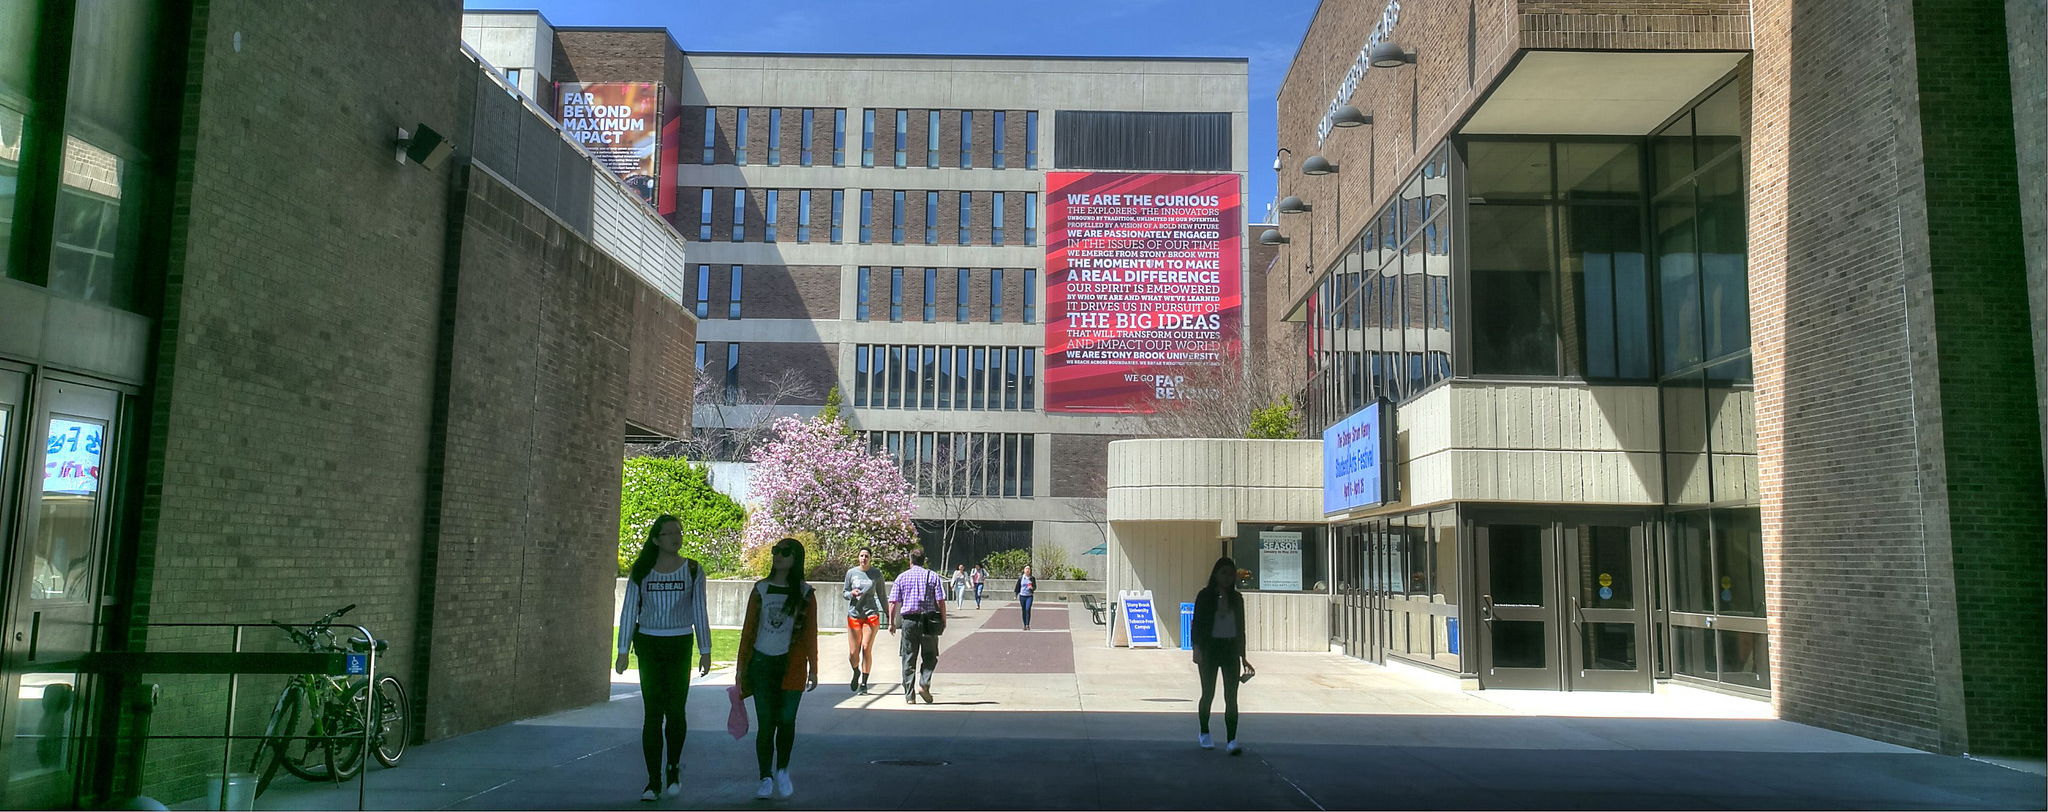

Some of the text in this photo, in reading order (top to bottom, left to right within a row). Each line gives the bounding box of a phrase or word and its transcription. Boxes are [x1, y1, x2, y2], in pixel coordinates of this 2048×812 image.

[564, 92, 594, 105] FAR
[563, 105, 631, 118] BEYOND
[563, 118, 644, 131] MAXIMUM
[567, 131, 623, 144] MPACT
[1067, 194, 1219, 207] WE ARE THE CURIOUS
[1067, 206, 1085, 214] THE
[1161, 208, 1220, 216] INNOVATORS
[1083, 230, 1103, 238] ARE
[1104, 230, 1172, 239] PASSIONATELY
[1173, 231, 1220, 239] ENGAGED
[1067, 239, 1220, 250] IN THE ISSUES OF OUR TIME
[1067, 259, 1091, 268] THE
[1166, 259, 1183, 269] TO
[1185, 260, 1220, 269] MAKE
[1067, 270, 1220, 284] A REAL DIFFERENCE
[1067, 283, 1220, 294] OUR SPIRIT IS EMPOWERED
[1067, 302, 1220, 313] IT DRIVES US IN PURSUIT OF
[1067, 312, 1220, 330] THE BIG IDEAS
[1092, 330, 1115, 338] WILL
[1116, 330, 1172, 339] TRANSFORM
[1174, 331, 1194, 339] OUR
[1195, 331, 1220, 339] LIVES
[1066, 339, 1220, 351] AND IMPACT OUR WORLD
[1166, 352, 1220, 360] UNIVERSITY
[1124, 374, 1139, 382] WE
[1349, 452, 1357, 474] Arts
[1357, 444, 1374, 471] Festival
[1263, 542, 1299, 550] SEASON
[664, 582, 684, 590] BEAU
